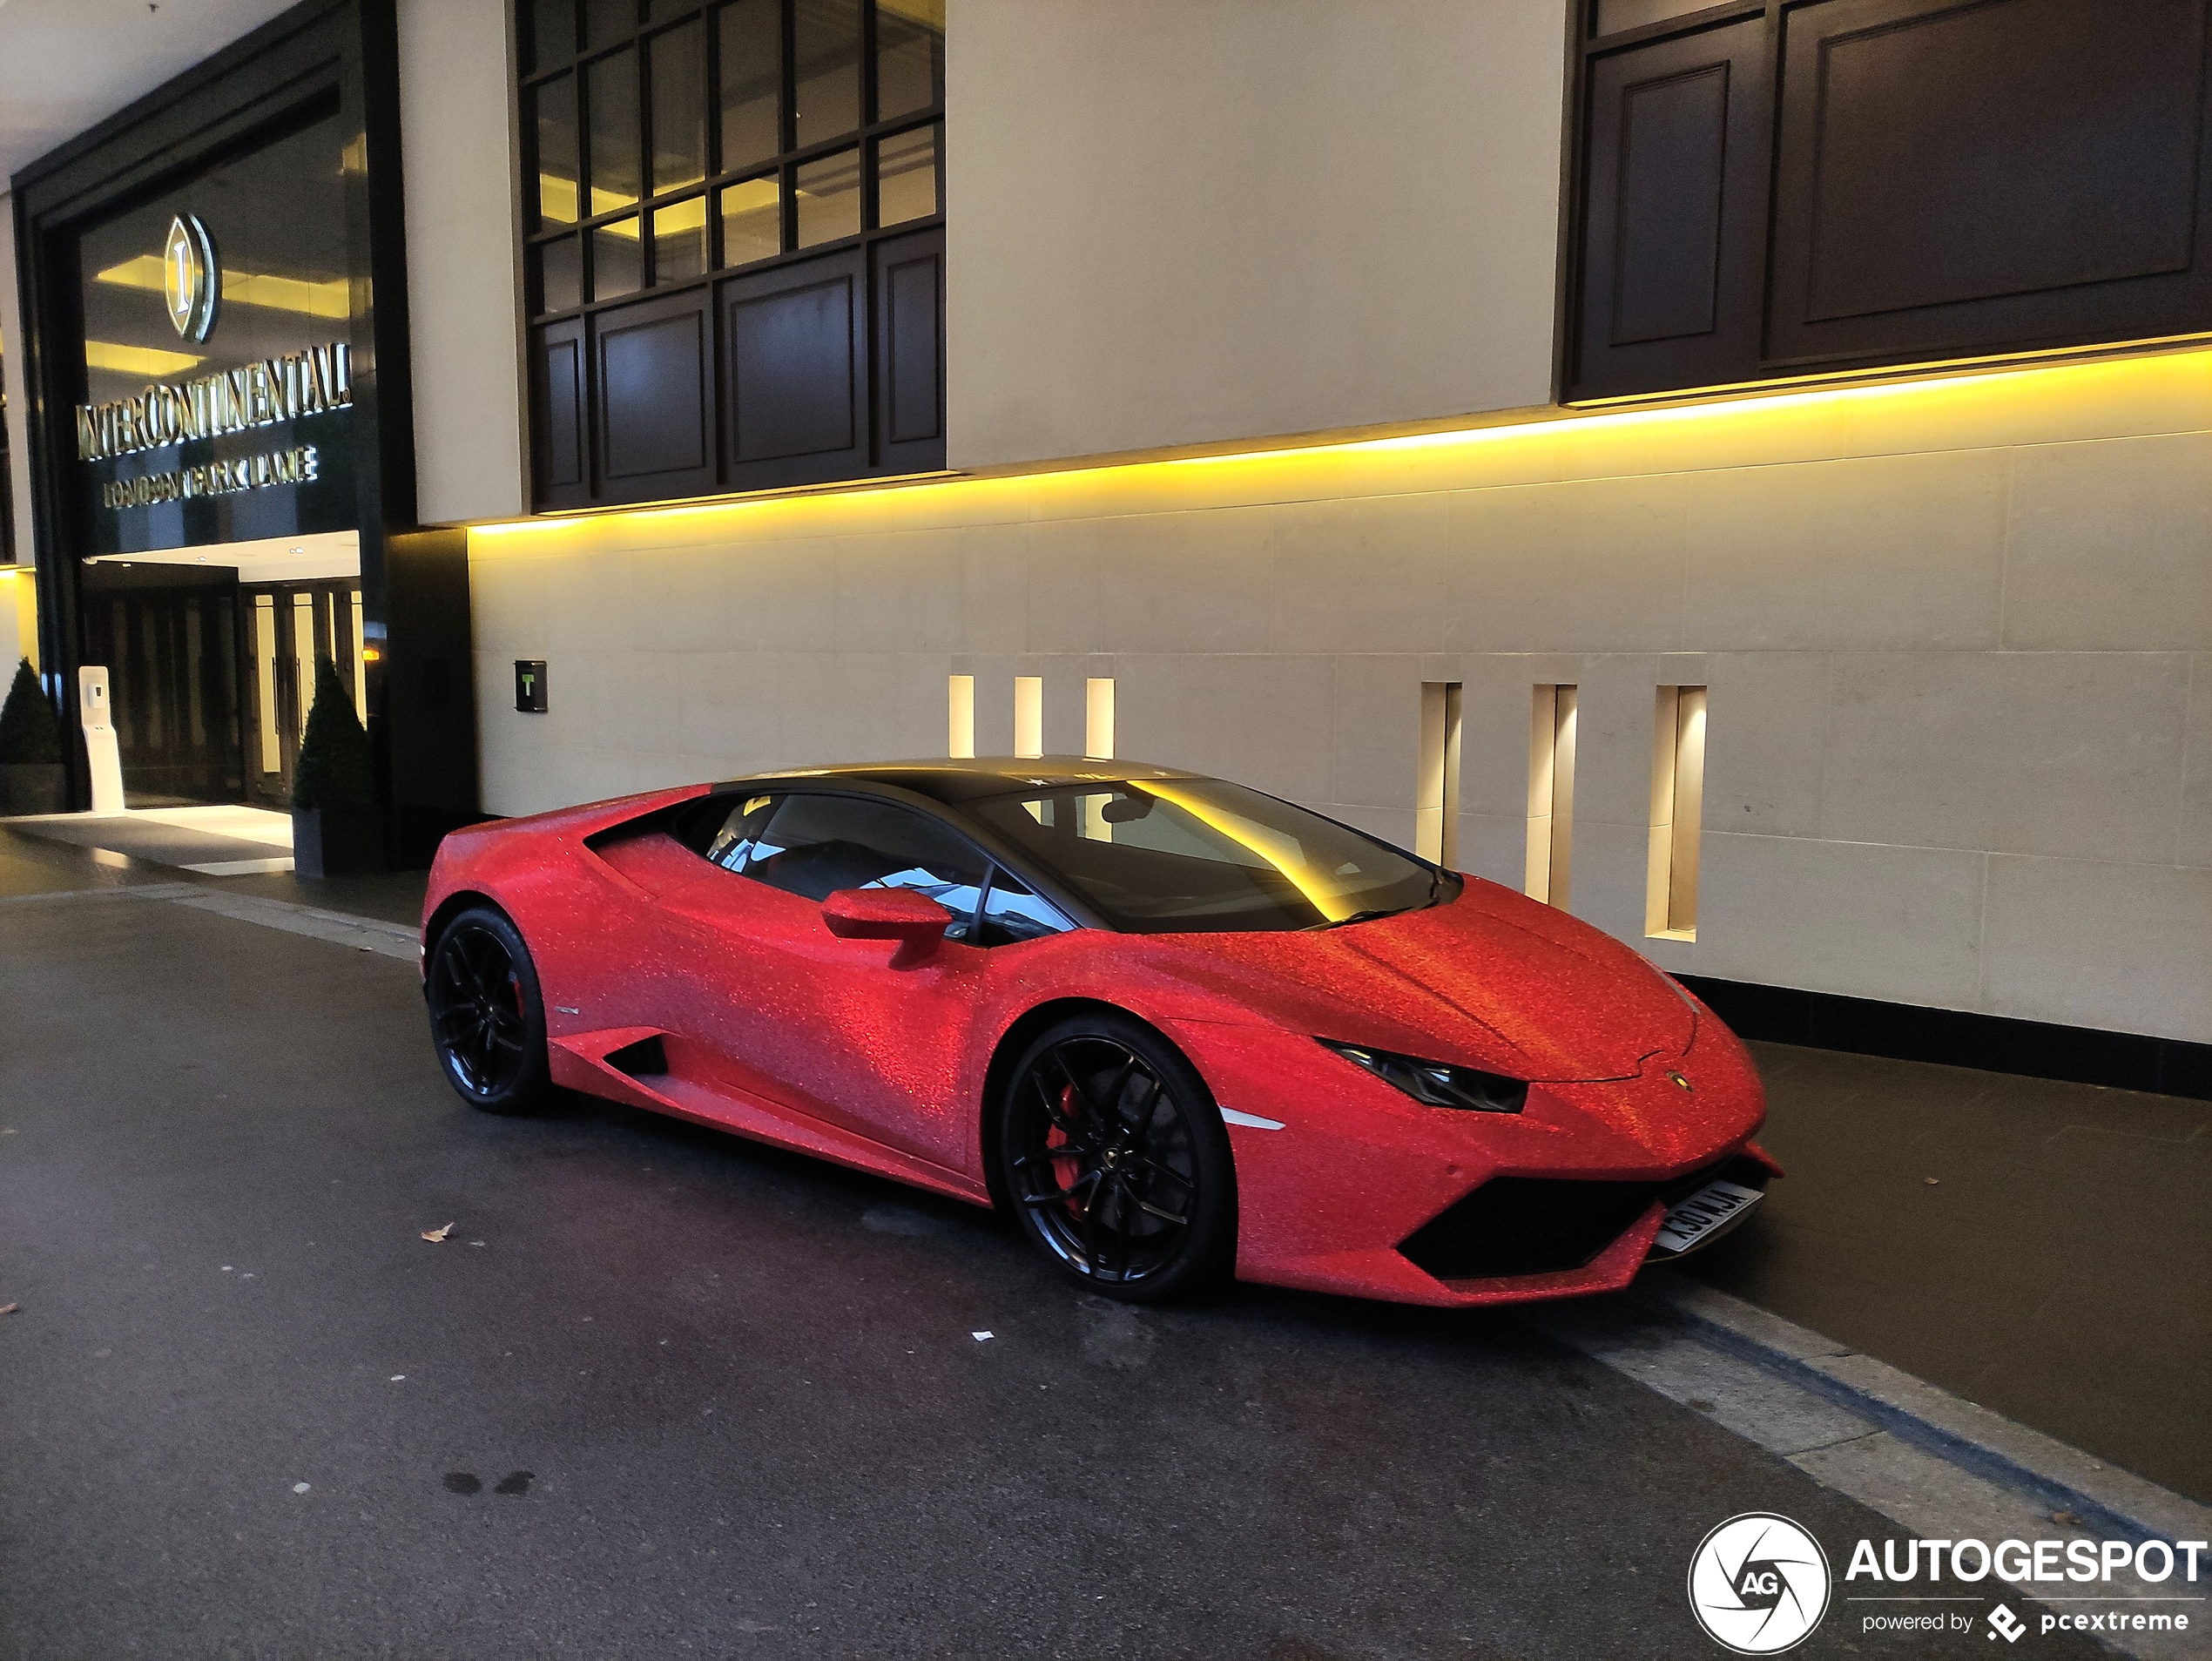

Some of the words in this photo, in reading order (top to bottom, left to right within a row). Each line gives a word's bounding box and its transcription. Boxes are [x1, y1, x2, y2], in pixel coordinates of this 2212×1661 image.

[104, 470, 191, 509] LONDON
[191, 460, 250, 497] PARK
[250, 445, 318, 488] LANE
